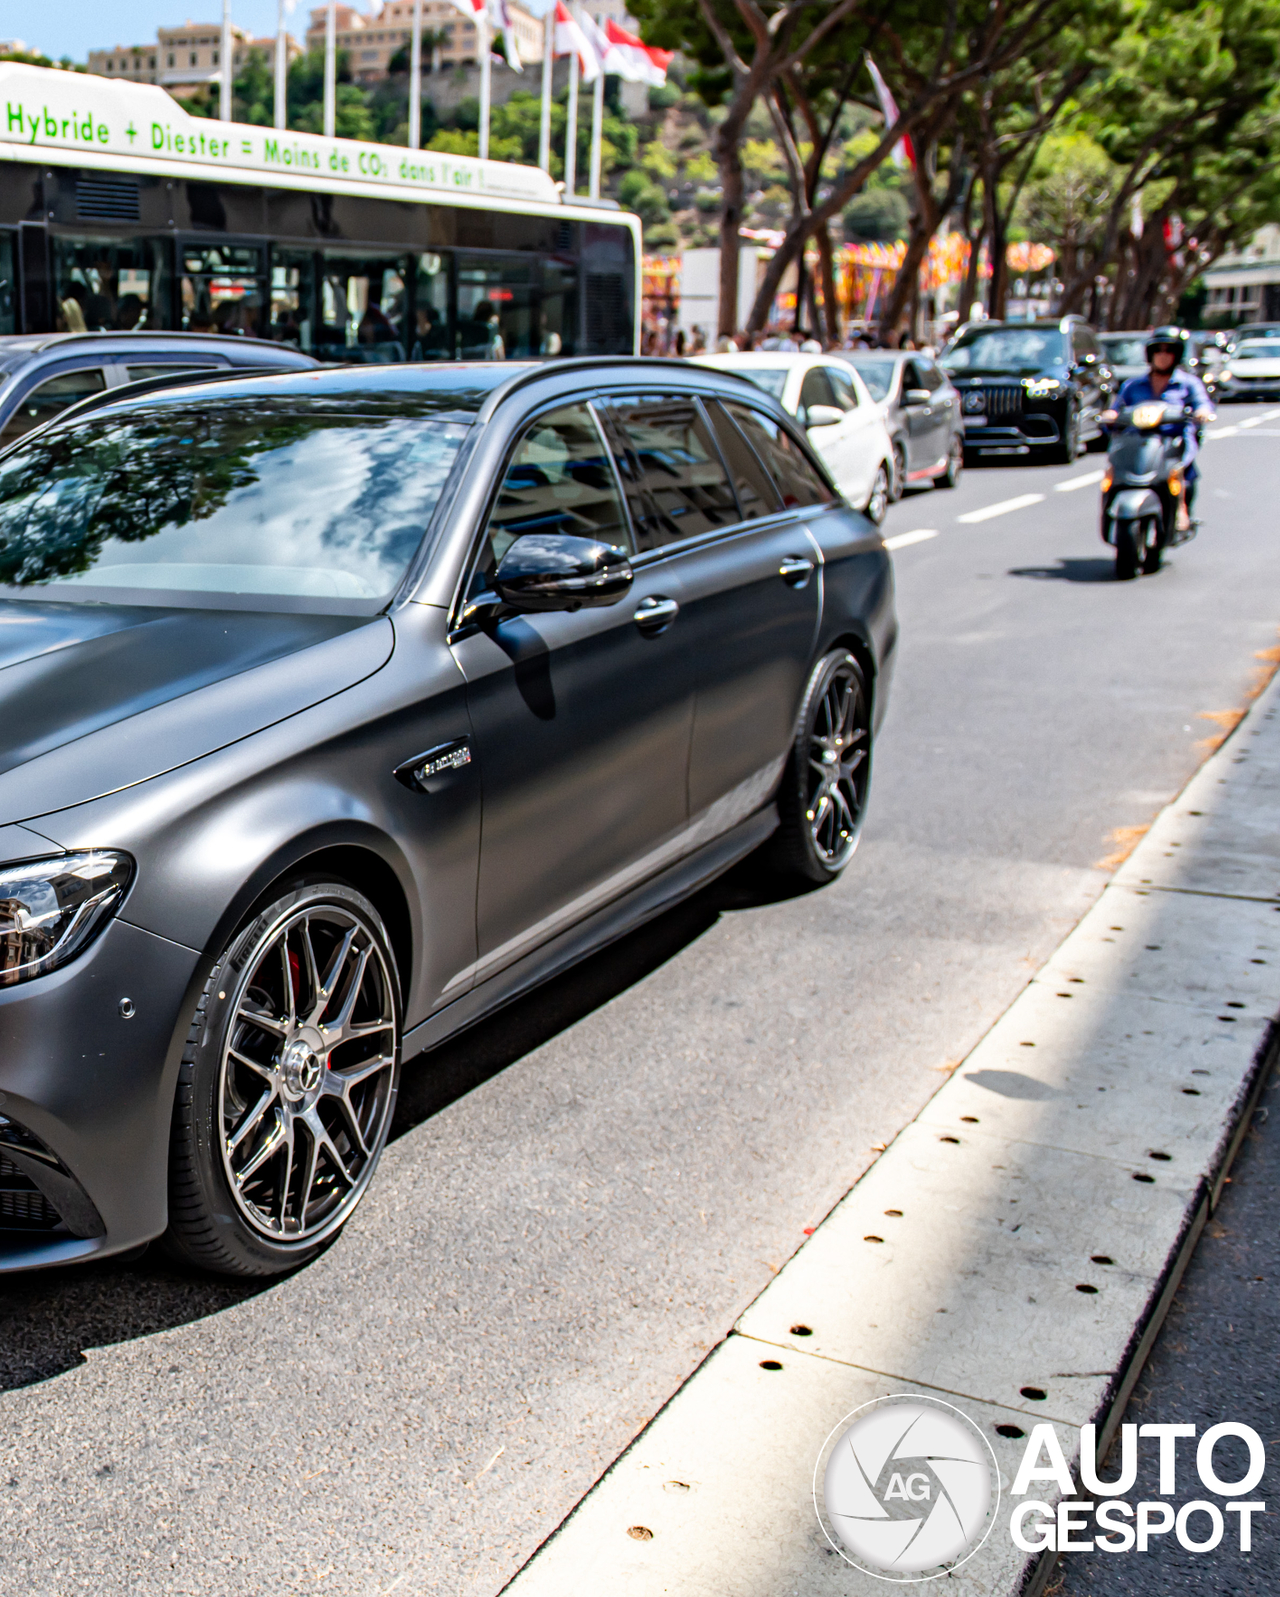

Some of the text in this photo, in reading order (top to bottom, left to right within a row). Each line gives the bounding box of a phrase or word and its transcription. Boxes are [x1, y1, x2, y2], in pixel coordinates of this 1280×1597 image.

[6, 102, 110, 145] Hybride
[151, 122, 229, 158] Diester
[264, 138, 320, 169] Moins
[329, 148, 349, 172] de
[399, 157, 435, 182] dans
